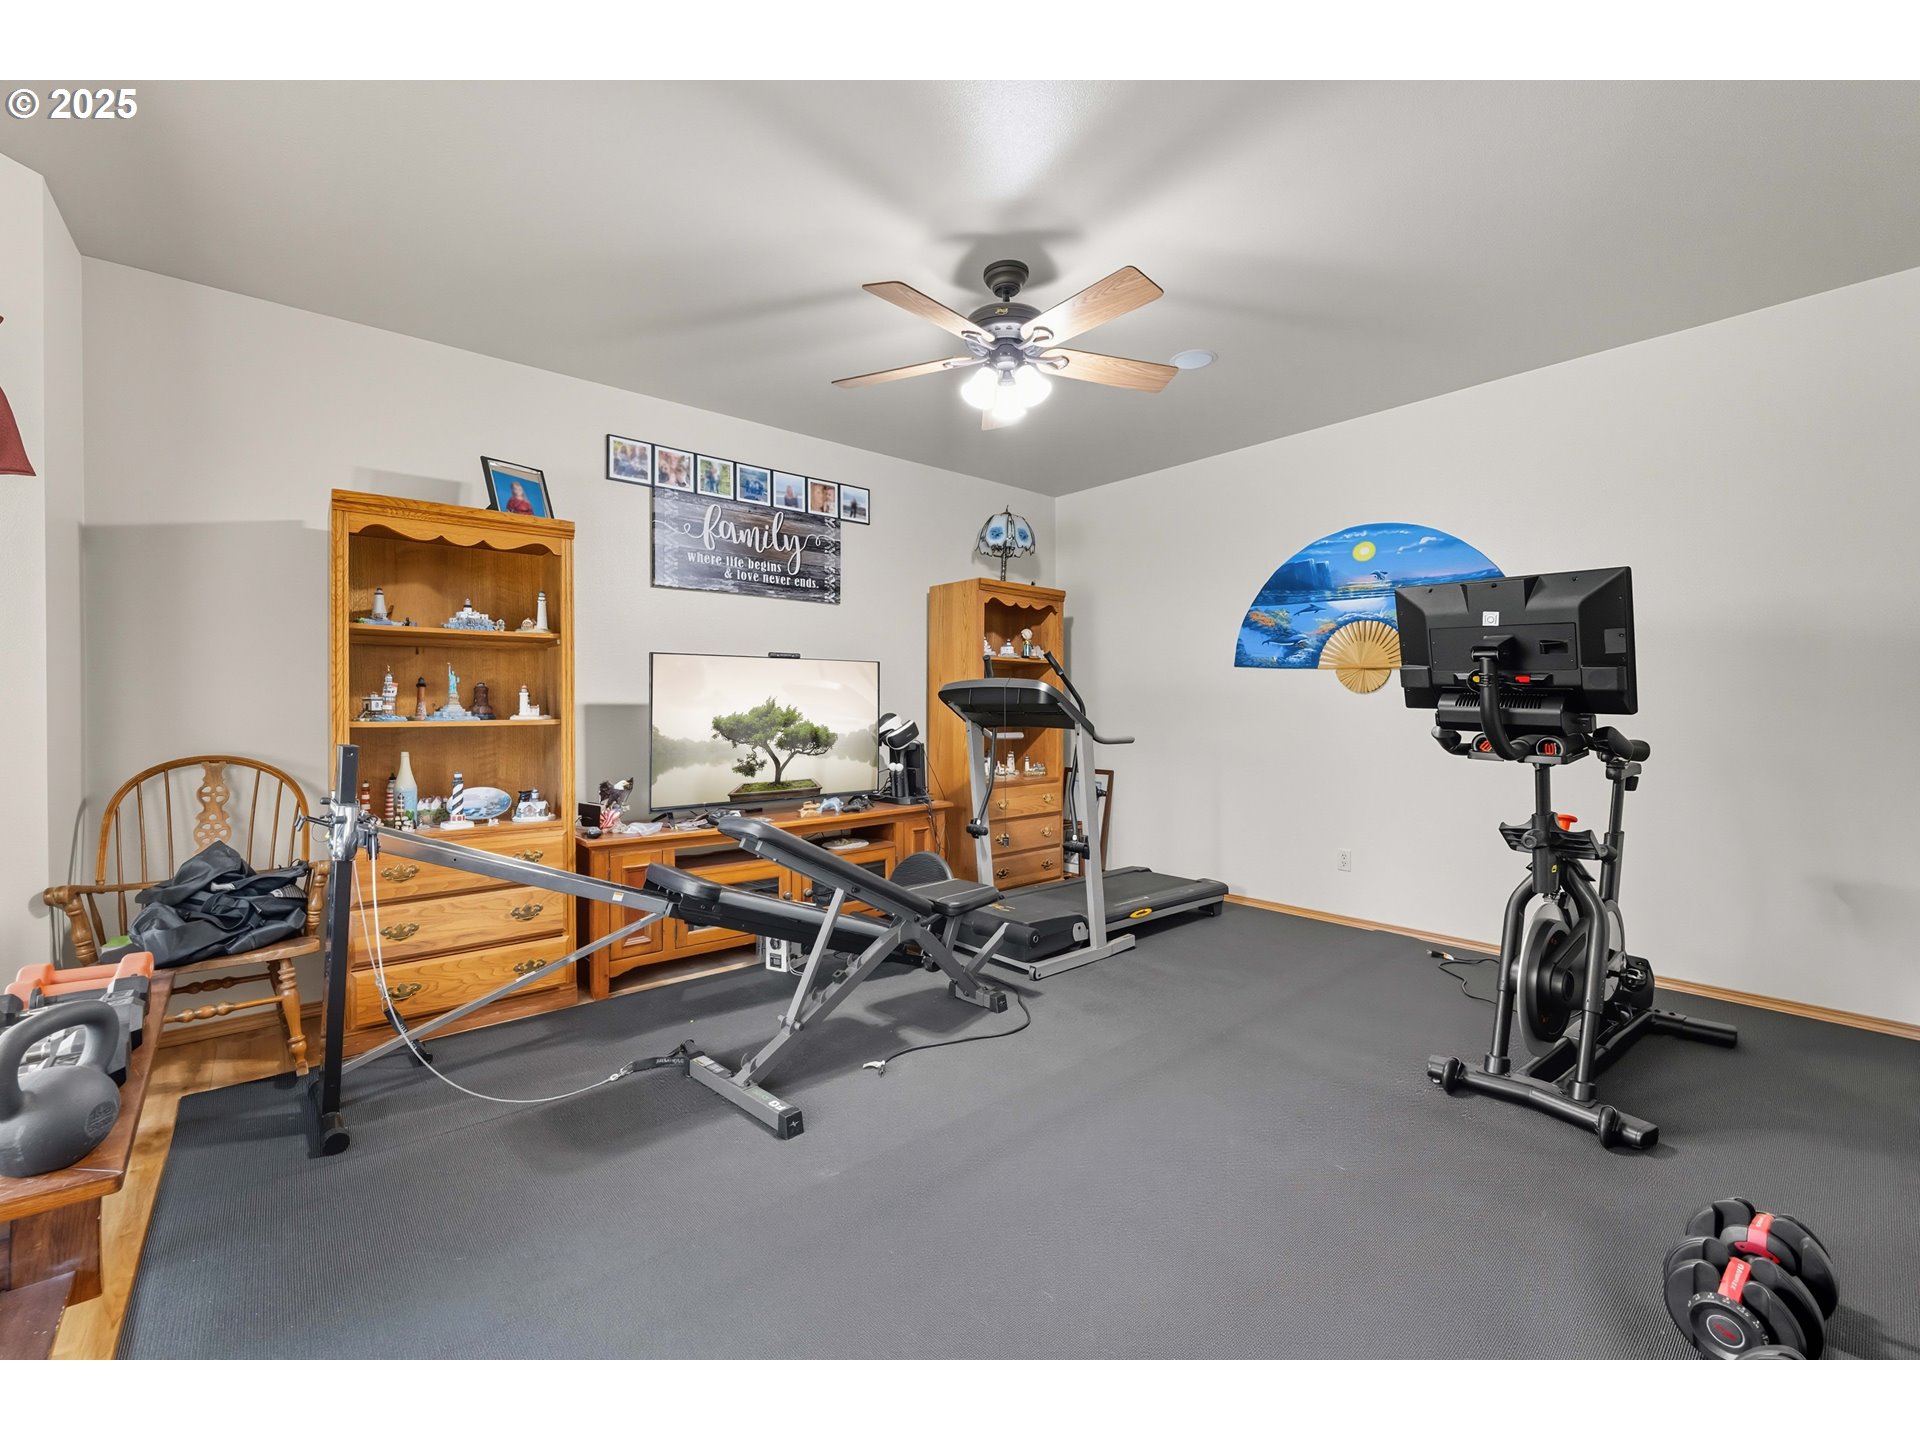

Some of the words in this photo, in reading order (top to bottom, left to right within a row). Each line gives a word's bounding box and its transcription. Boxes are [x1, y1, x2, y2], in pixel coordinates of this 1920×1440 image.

[692, 503, 815, 576] family
[687, 551, 722, 566] where
[726, 555, 744, 568] life
[748, 557, 782, 573] begins
[724, 568, 733, 579] &
[737, 569, 759, 582] love
[763, 574, 791, 586] never
[794, 577, 820, 589] ends.
